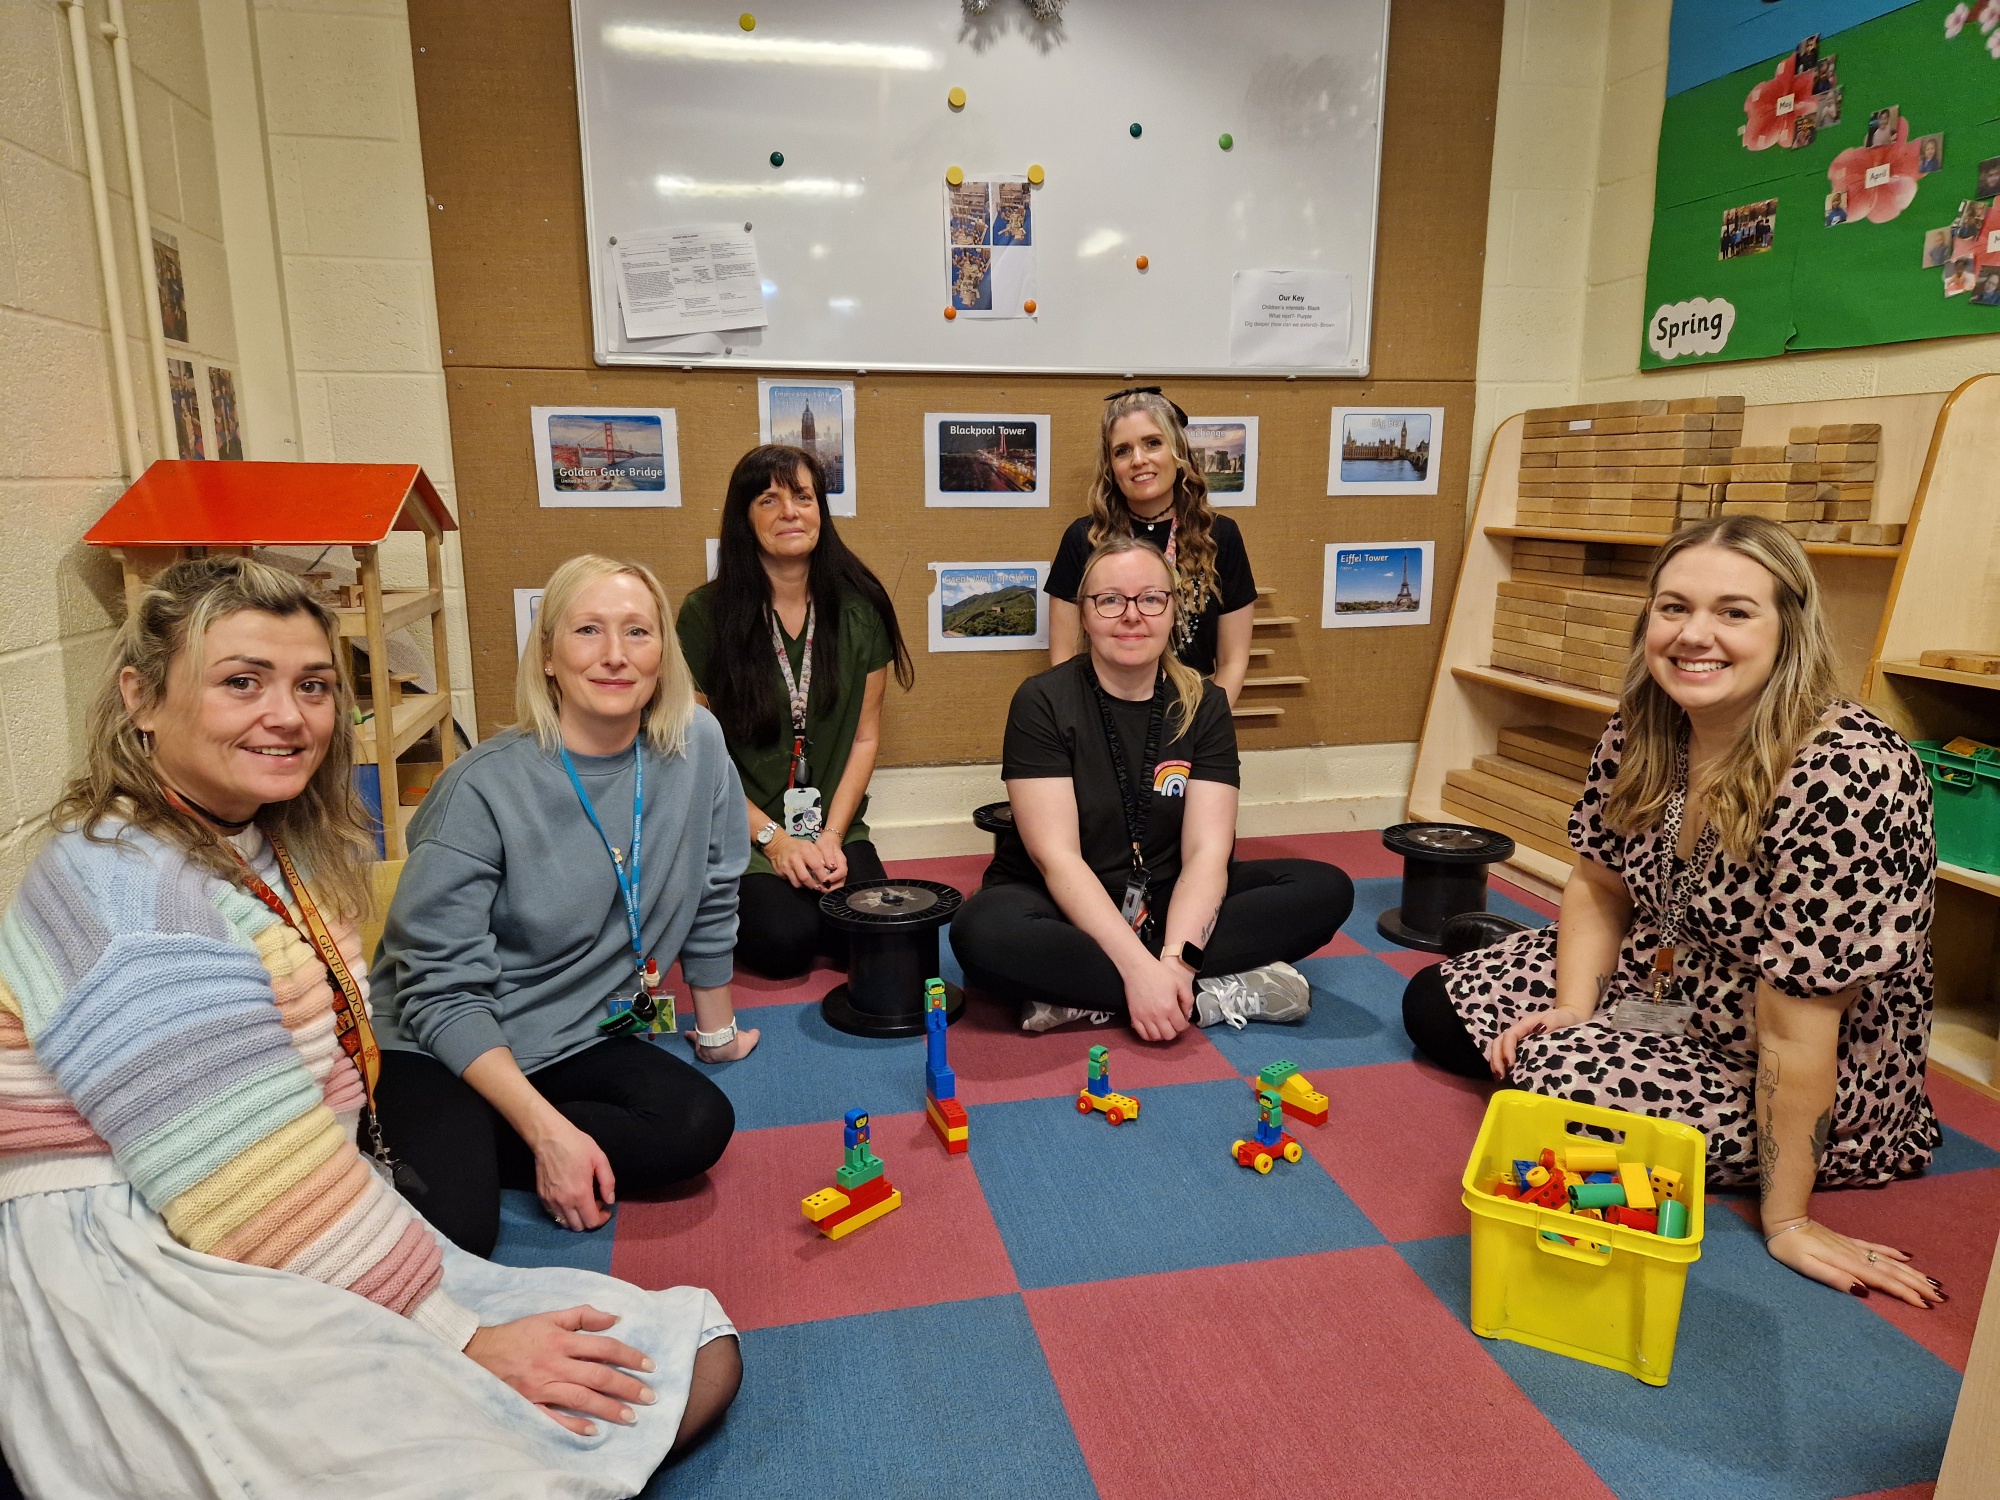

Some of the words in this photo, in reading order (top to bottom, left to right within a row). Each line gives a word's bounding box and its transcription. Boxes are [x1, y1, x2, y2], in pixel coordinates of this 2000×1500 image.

[1779, 101, 1792, 110] May
[1870, 170, 1886, 182] April
[1278, 294, 1291, 302] Our
[1292, 294, 1305, 303] Key
[1656, 312, 1723, 349] Spring
[1371, 417, 1386, 429] Big
[1387, 418, 1404, 427] Ben
[950, 424, 996, 438] Blackpool
[998, 426, 1027, 435] Tower
[1187, 427, 1225, 439] nehenge
[559, 467, 597, 477] Golden
[600, 467, 626, 477] Gate
[628, 467, 663, 479] Bridge
[1340, 553, 1362, 565] Eiffel
[1364, 553, 1389, 562] Tower
[944, 574, 971, 584] Great
[973, 573, 994, 583] Wall
[997, 574, 1008, 585] of
[1008, 573, 1035, 583] China
[635, 774, 643, 798] Meadow
[634, 813, 643, 842] Watercliffe
[633, 843, 641, 867] Meadow
[318, 934, 366, 1024] GRYFFINDOR
